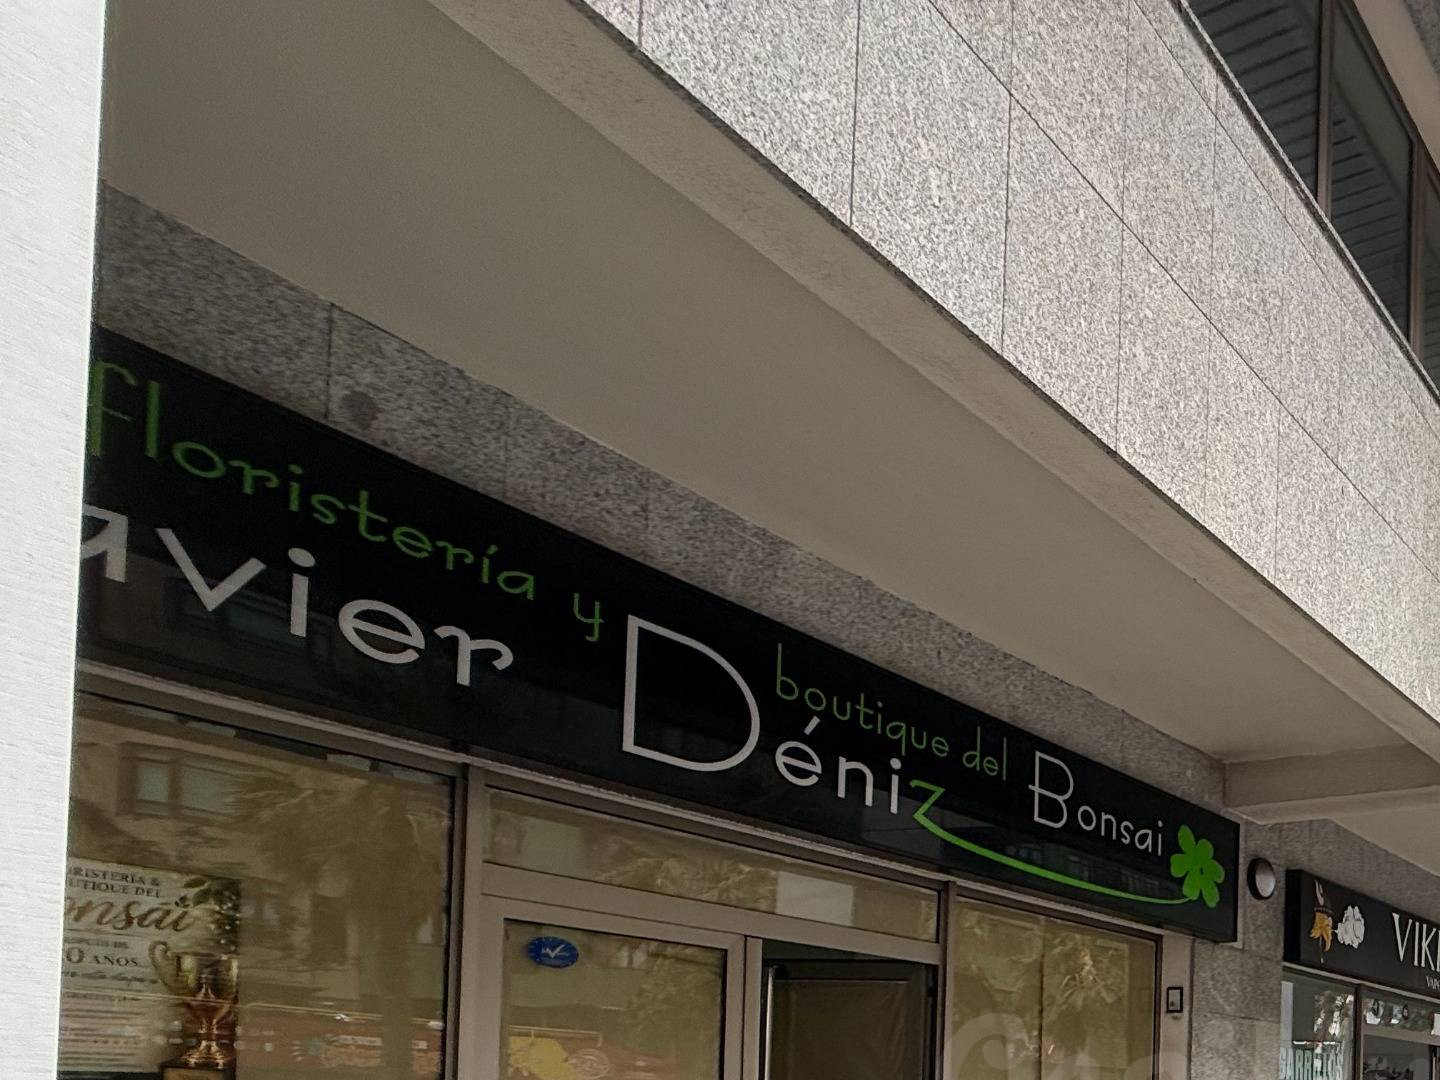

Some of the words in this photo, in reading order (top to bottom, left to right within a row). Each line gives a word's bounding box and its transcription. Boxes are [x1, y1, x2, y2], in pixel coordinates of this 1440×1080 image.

[573, 591, 606, 643] y
[775, 642, 950, 759] boutique
[962, 725, 1008, 781] del
[1027, 750, 1164, 857] Bonsai
[622, 613, 946, 826] Déniz
[69, 866, 146, 886] RISTERÍA
